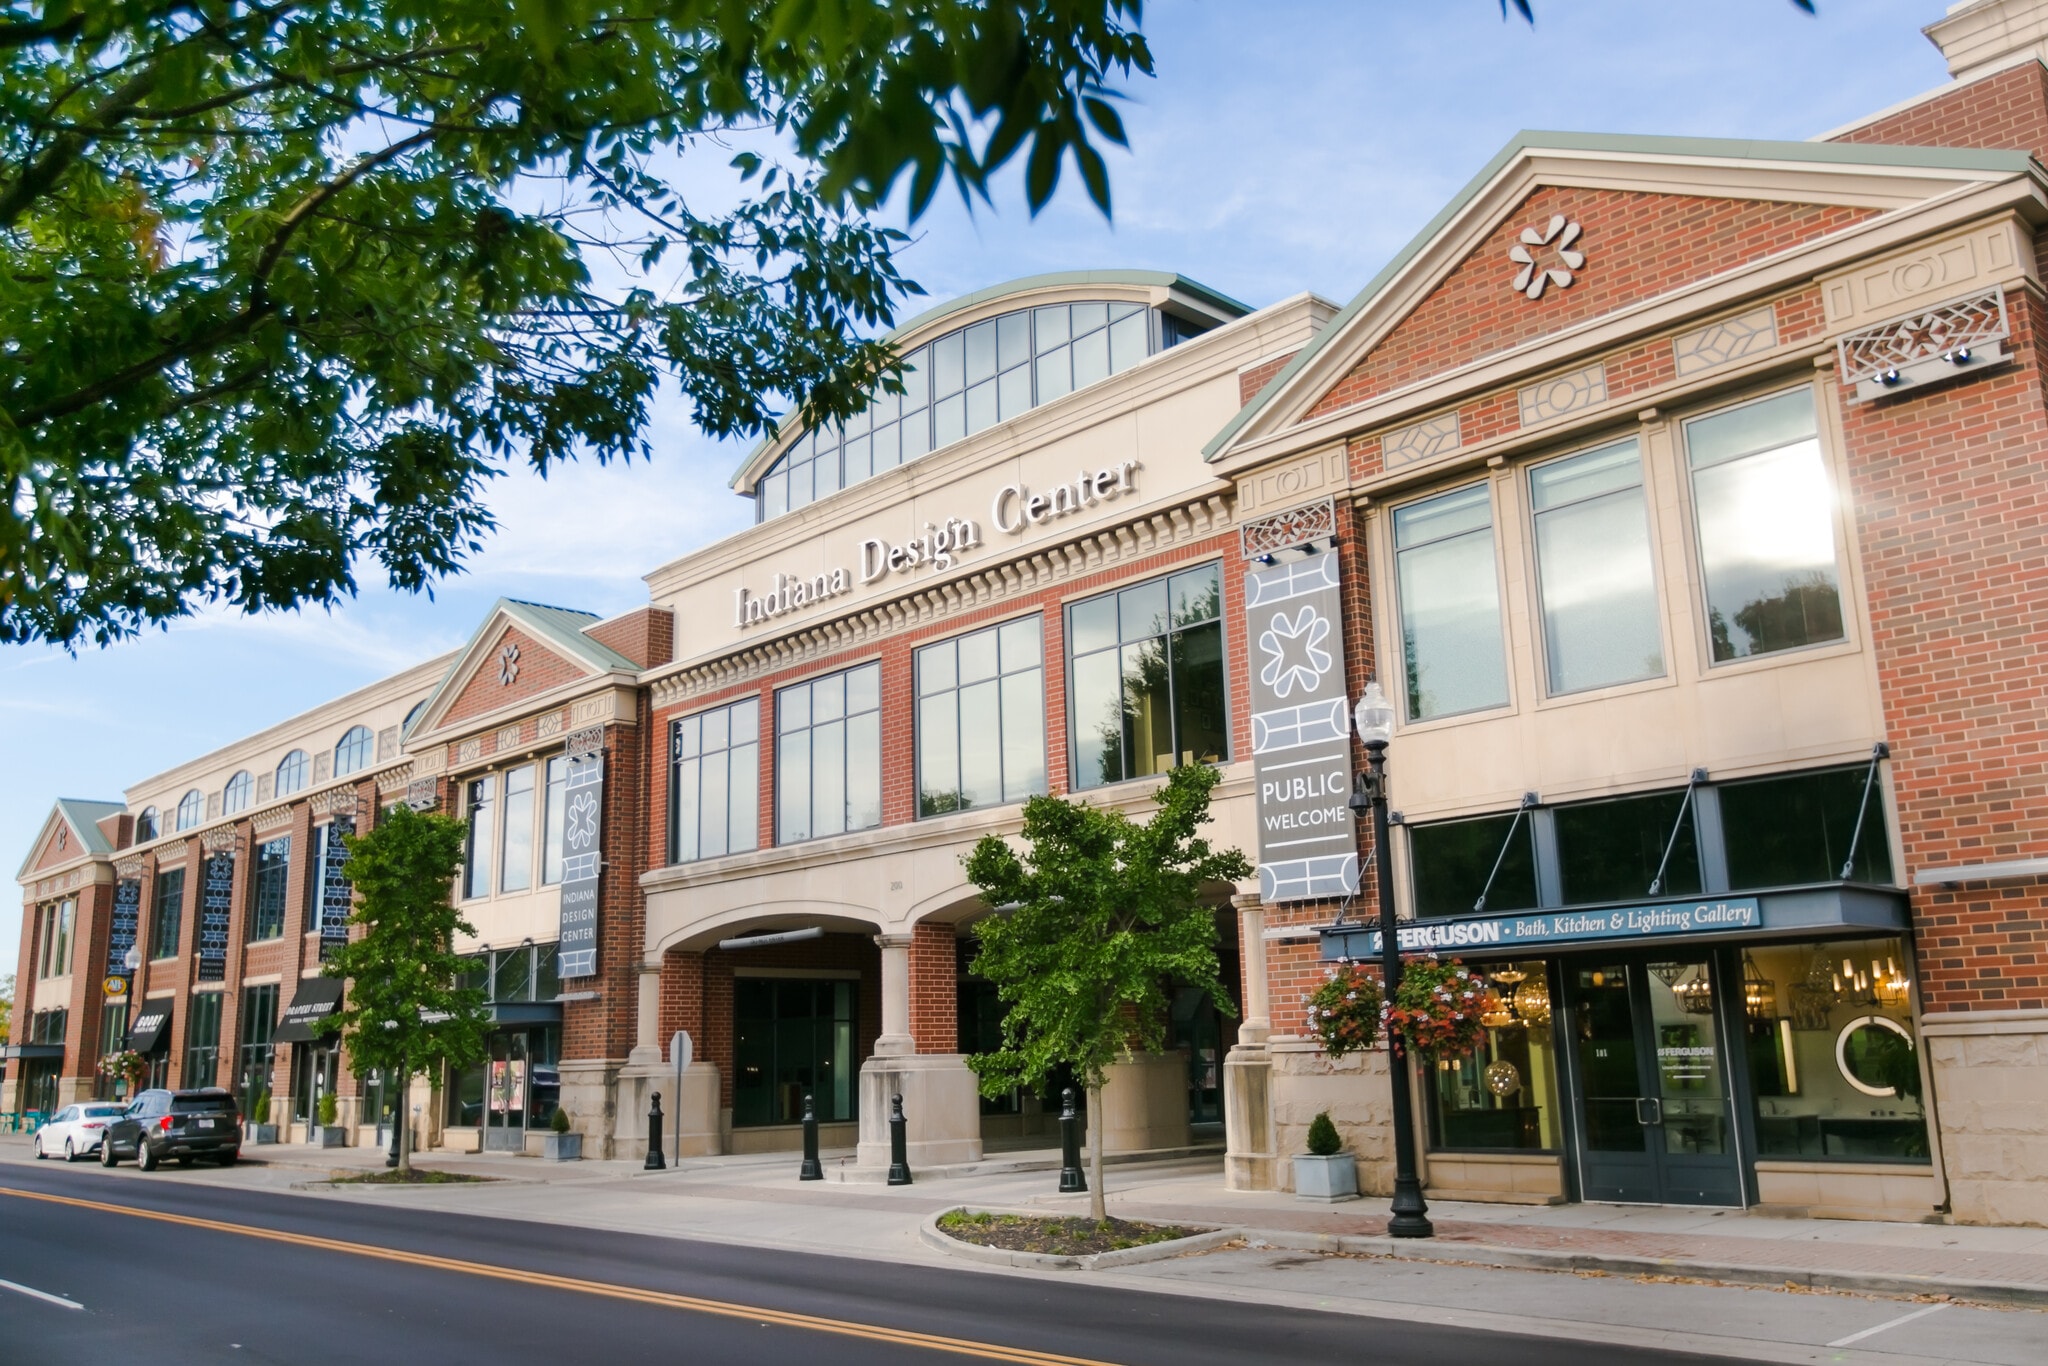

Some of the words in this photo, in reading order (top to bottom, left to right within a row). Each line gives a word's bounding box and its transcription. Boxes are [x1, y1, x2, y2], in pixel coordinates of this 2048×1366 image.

[733, 567, 851, 628] Indiana
[857, 516, 980, 585] Design
[991, 458, 1141, 535] Center
[1262, 771, 1345, 805] PUBLIC
[1264, 806, 1346, 832] WELCOME
[563, 889, 595, 905] INDIANA
[562, 908, 595, 924] DESIGN
[1516, 919, 1550, 937] Bath,
[1554, 915, 1606, 934] Kitchen
[1610, 913, 1624, 930] &
[1628, 908, 1691, 933] Lighting
[1694, 904, 1752, 926] Gallery
[561, 927, 594, 943] CENTER
[1665, 1047, 1714, 1056] FERGUSON
